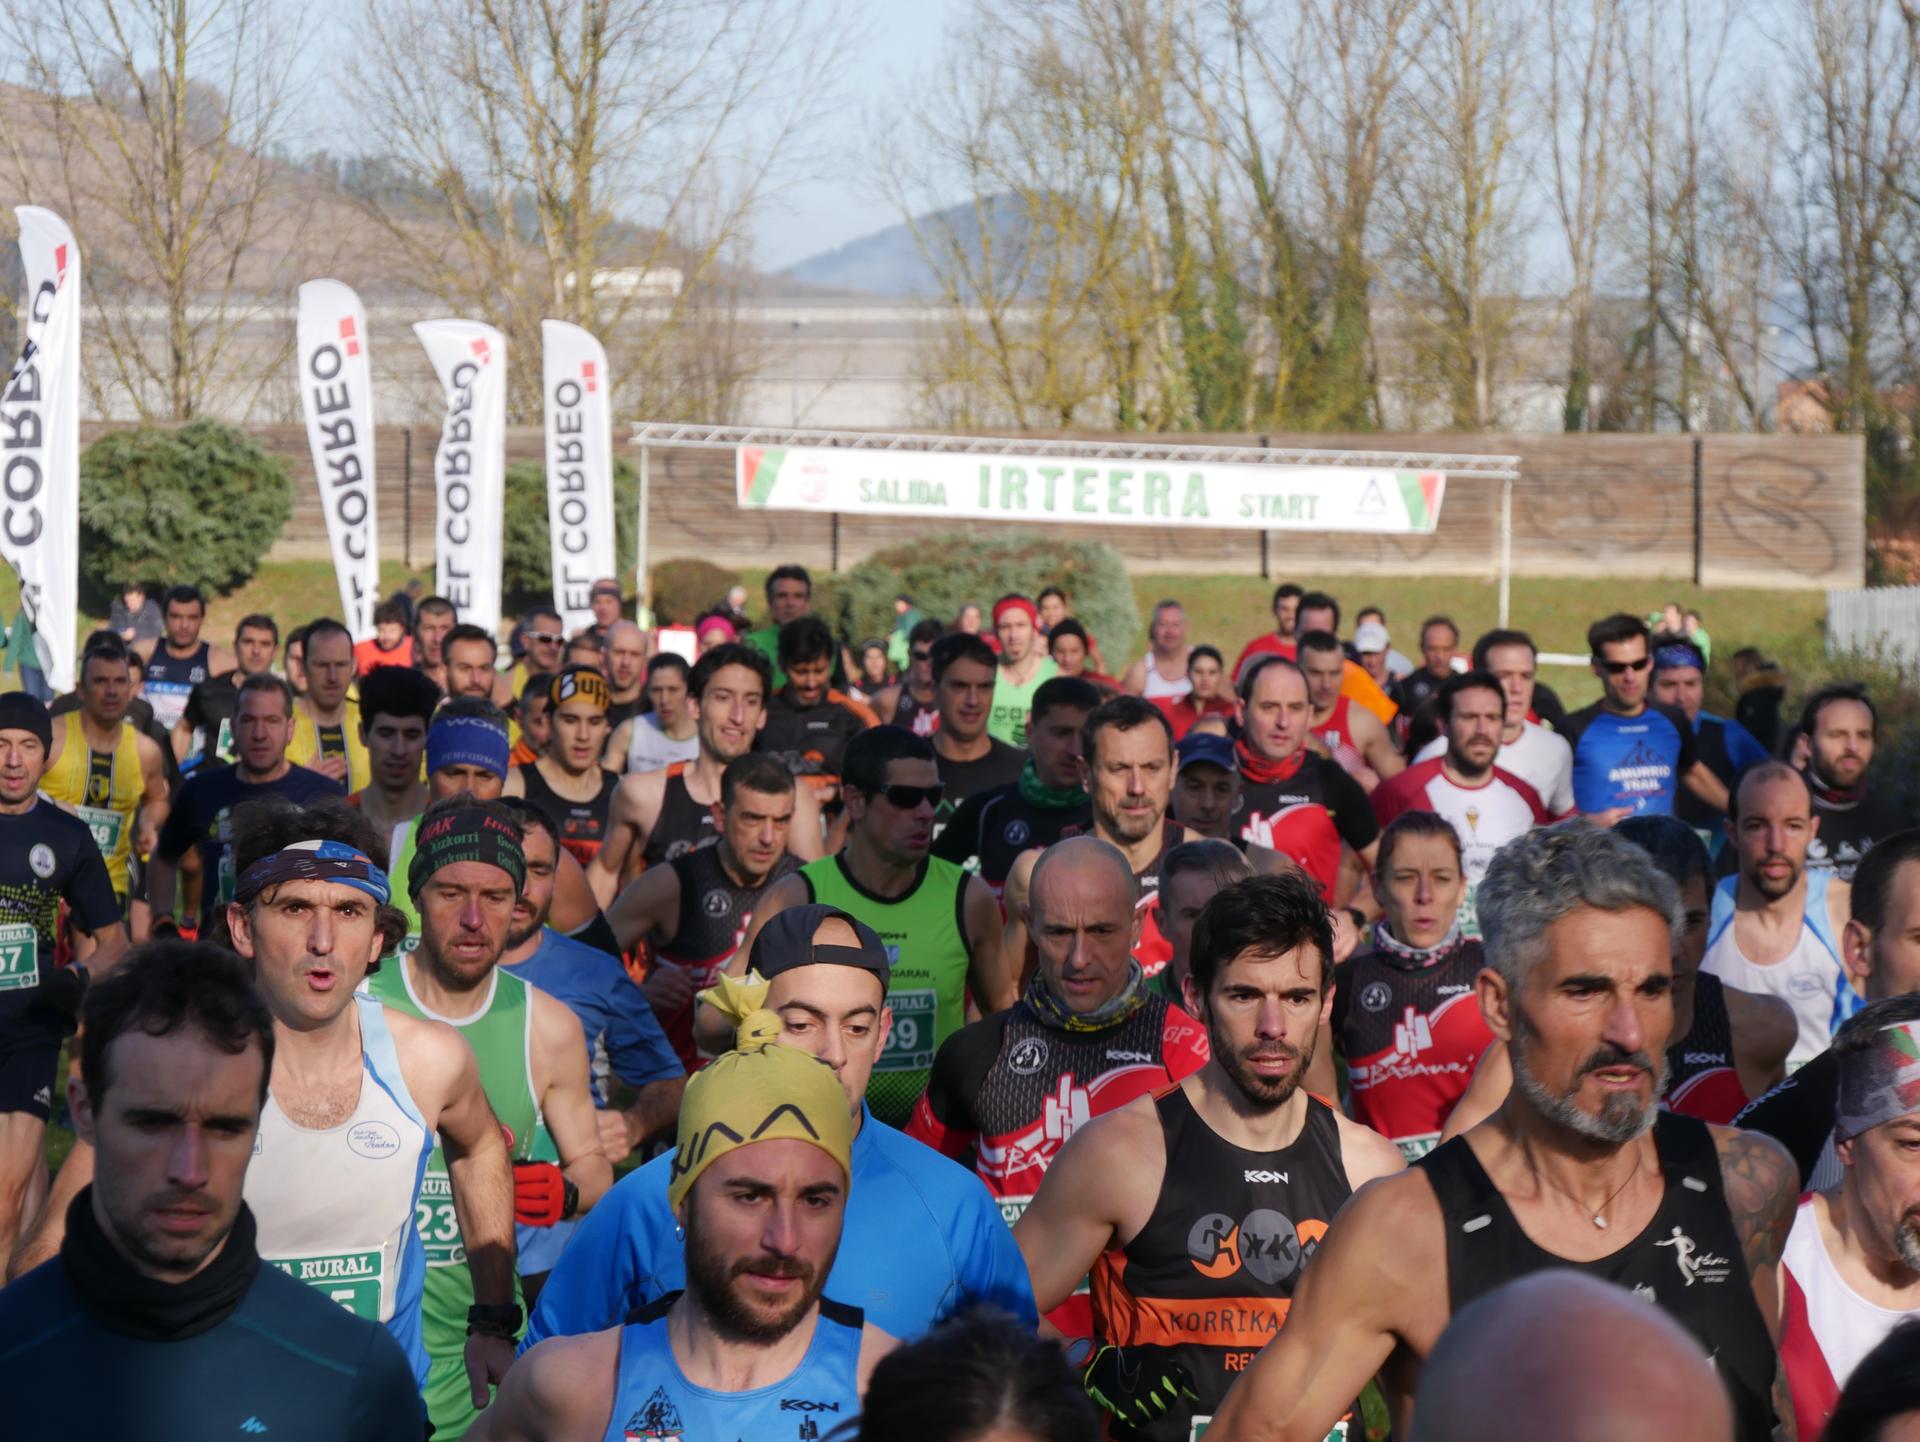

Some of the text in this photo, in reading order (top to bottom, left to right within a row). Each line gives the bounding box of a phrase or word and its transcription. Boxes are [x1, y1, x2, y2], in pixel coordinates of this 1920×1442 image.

[859, 464, 1319, 521] SALIDA IRTEERA START
[1609, 765, 1671, 782] AMURRIO
[299, 1256, 373, 1279] RURAL
[1170, 1309, 1287, 1333] KORRIKA
[1225, 1353, 1254, 1372] RE
